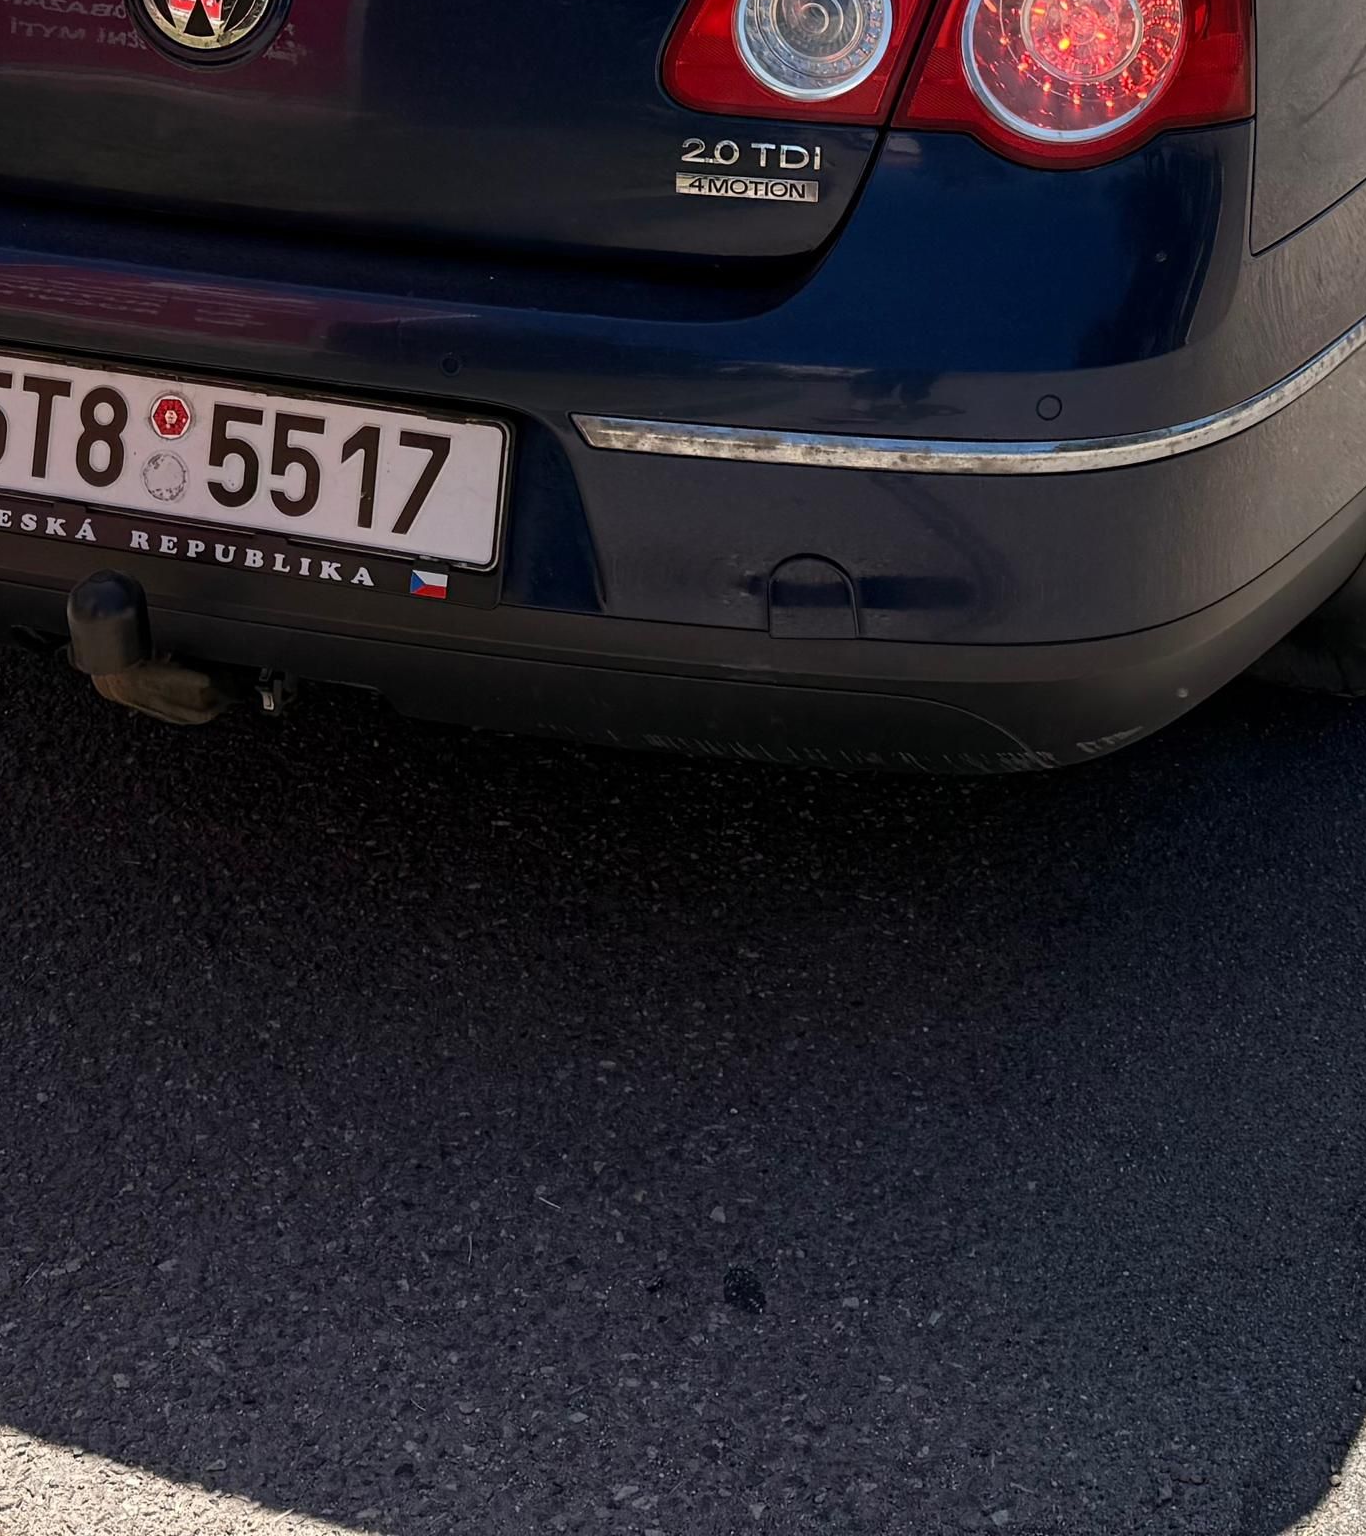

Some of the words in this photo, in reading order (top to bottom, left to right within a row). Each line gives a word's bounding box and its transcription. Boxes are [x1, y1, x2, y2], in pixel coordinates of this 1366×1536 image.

[751, 142, 821, 171] TDI
[688, 176, 806, 199] 4MOTION
[207, 403, 452, 536] 5517
[130, 529, 376, 587] REPUBLIKA
